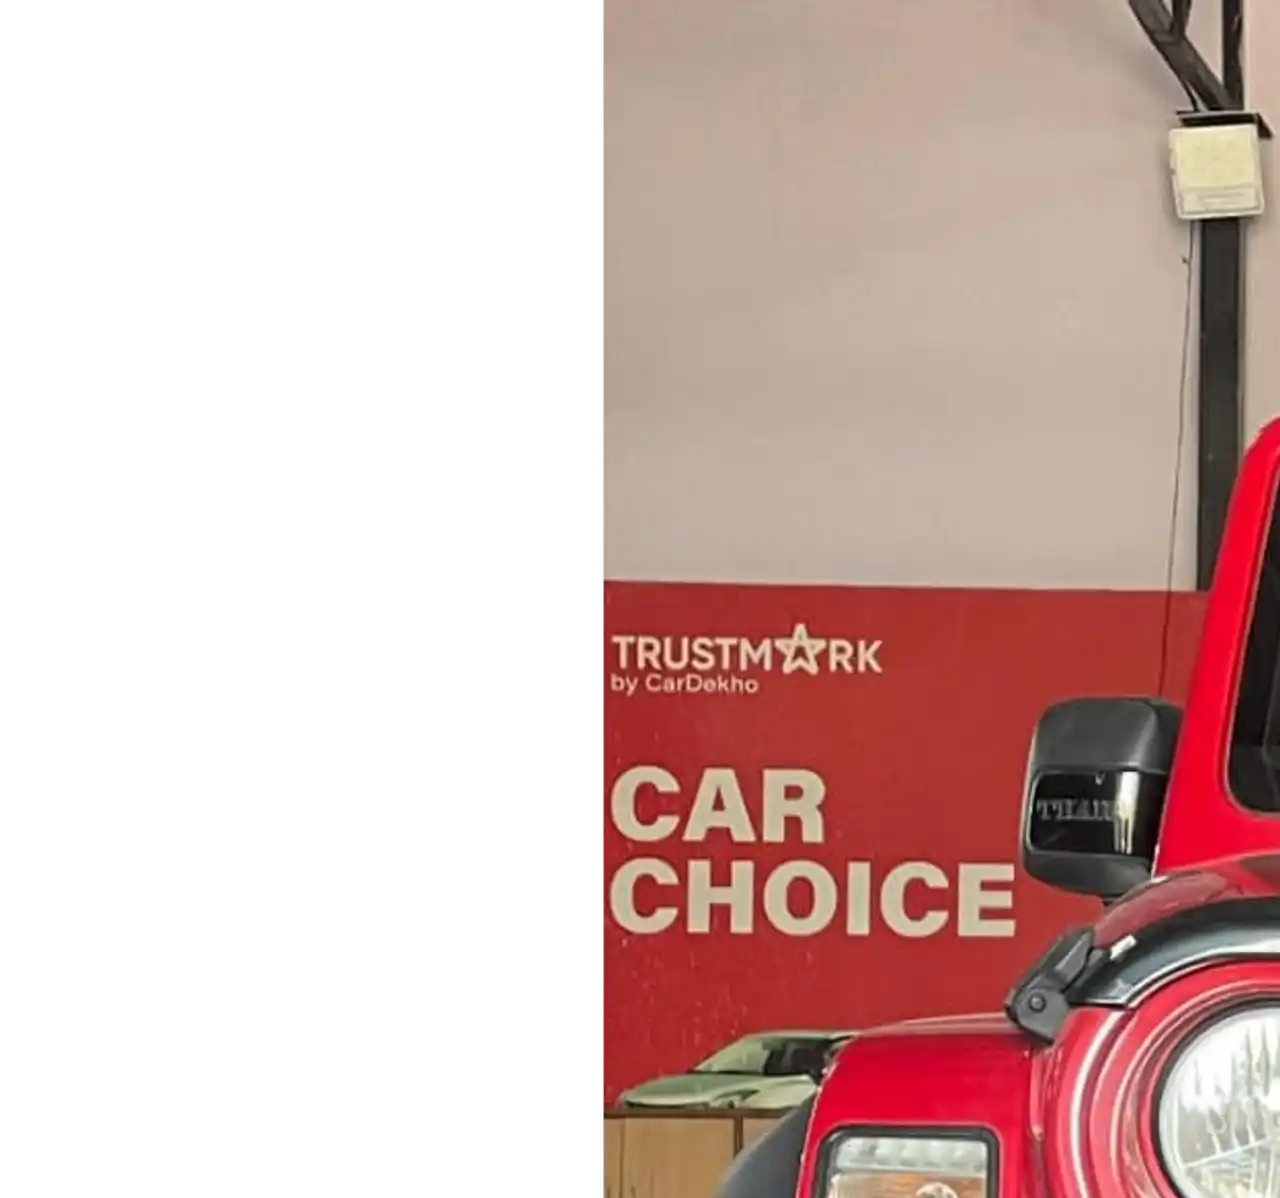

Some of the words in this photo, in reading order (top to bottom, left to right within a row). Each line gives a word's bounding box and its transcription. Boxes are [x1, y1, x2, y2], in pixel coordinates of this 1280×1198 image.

[611, 674, 638, 695] by
[646, 673, 759, 693] CarDekho
[609, 765, 827, 843] CAR
[609, 858, 1016, 937] CHOICE
